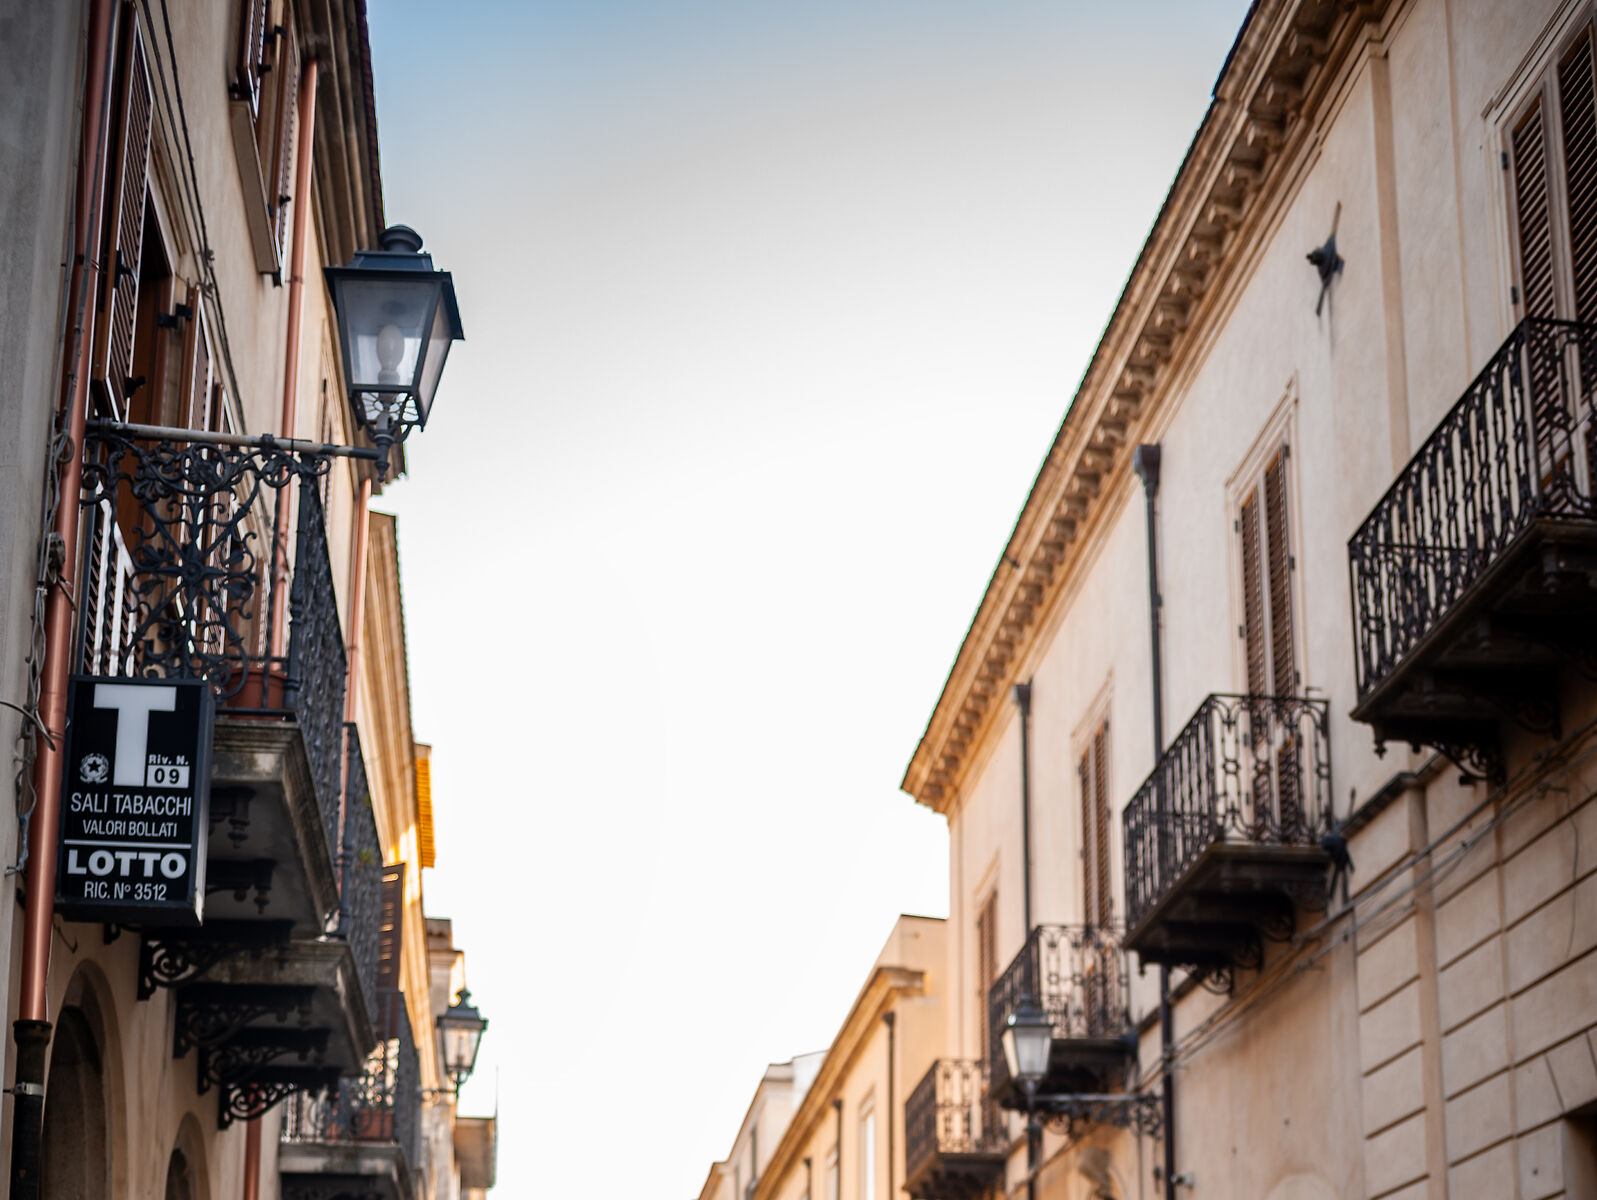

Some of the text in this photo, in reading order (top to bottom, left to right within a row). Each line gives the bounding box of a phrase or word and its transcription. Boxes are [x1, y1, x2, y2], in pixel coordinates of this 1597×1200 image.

[93, 683, 177, 788] T
[148, 754, 189, 766] Riv. N.
[154, 768, 180, 785] 09
[70, 792, 192, 816] SALI TABACCHI
[82, 819, 177, 837] VALORI BOLLATI
[67, 849, 187, 879] LOTTO
[84, 881, 110, 899] RIC.
[134, 883, 167, 901] 3512
